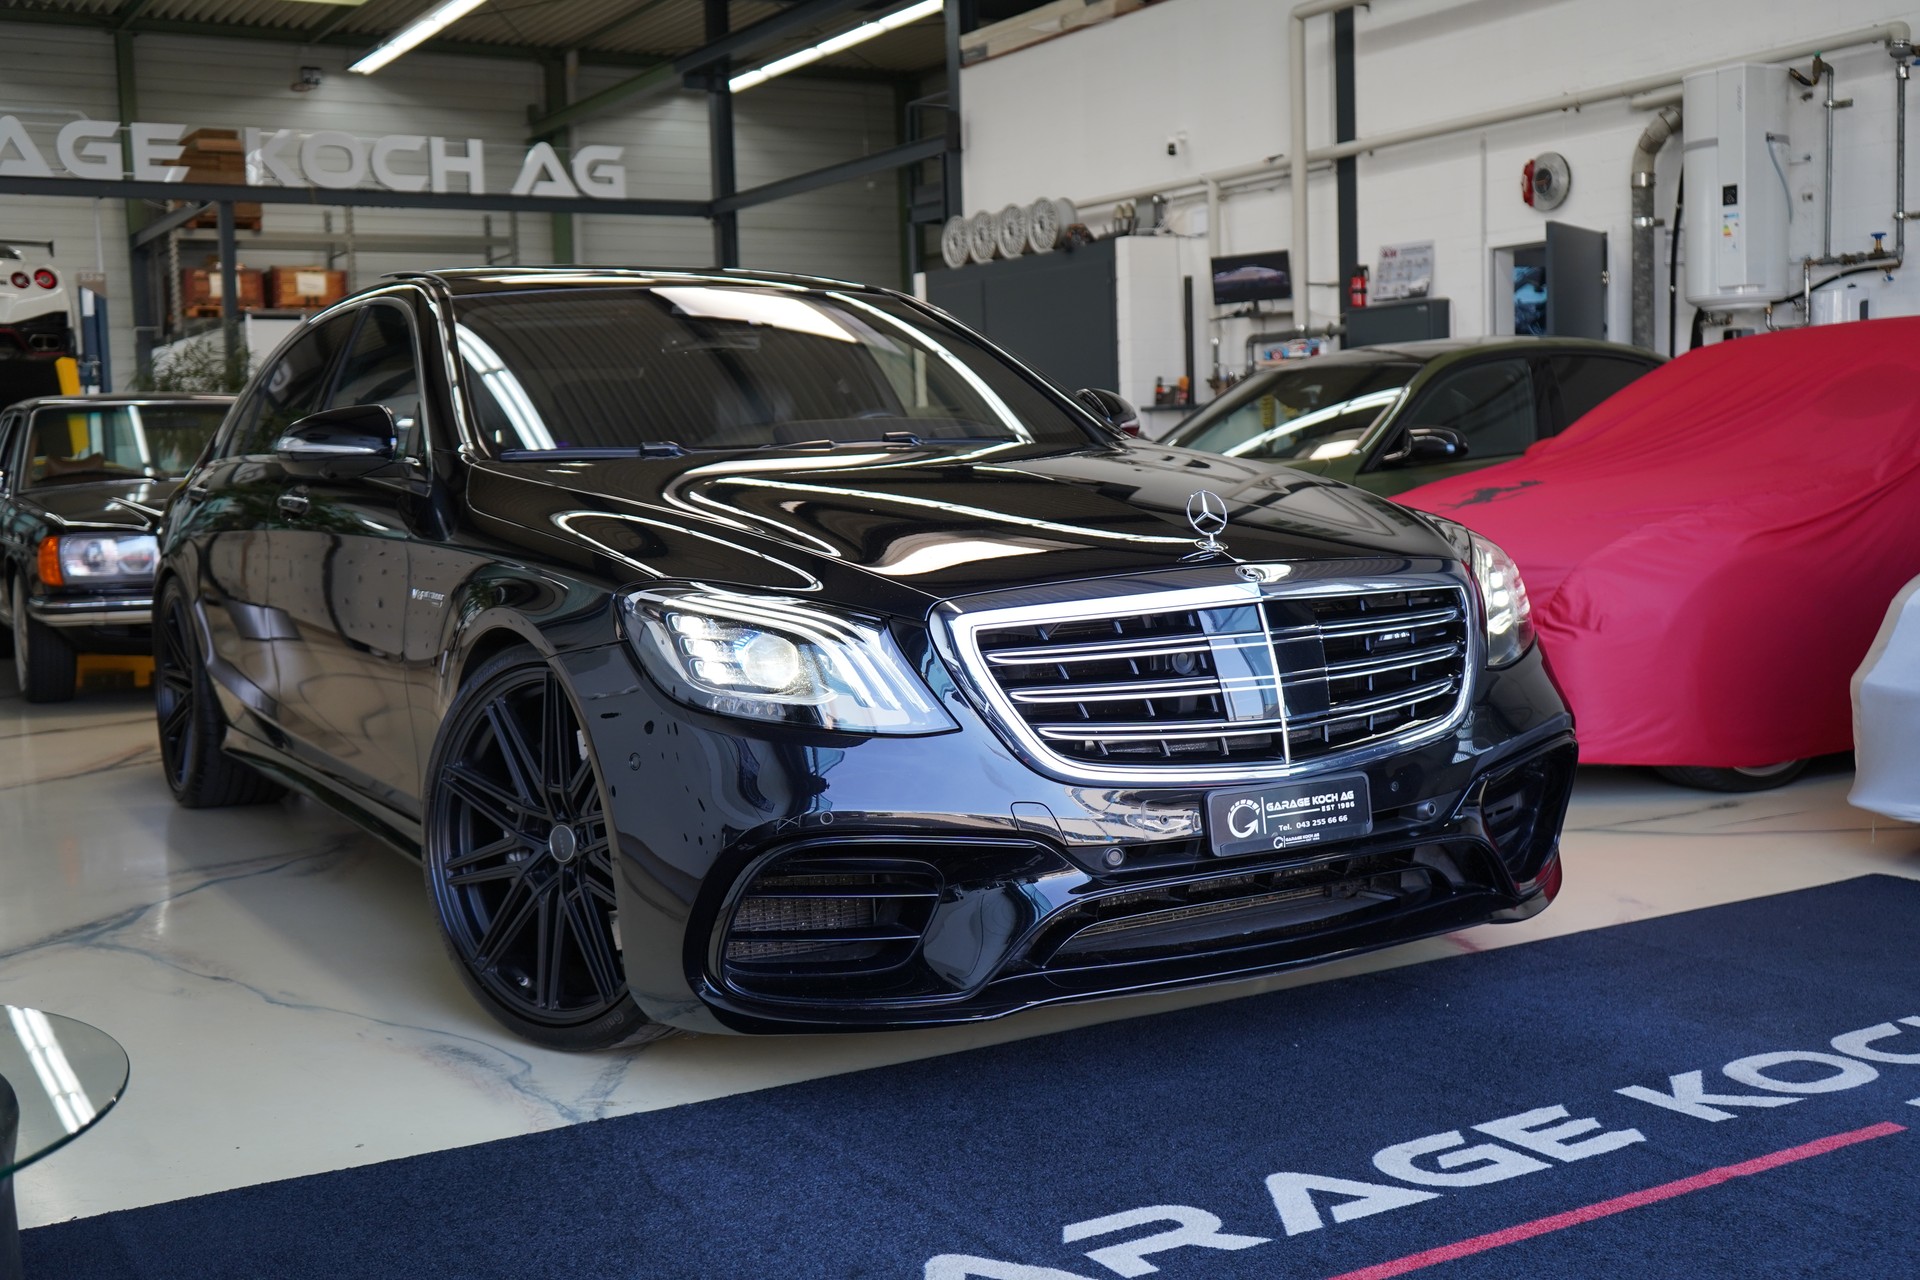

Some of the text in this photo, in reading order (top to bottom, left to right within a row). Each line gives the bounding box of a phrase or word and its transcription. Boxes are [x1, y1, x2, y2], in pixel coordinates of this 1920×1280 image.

[0, 115, 627, 199] AGE KOCH AG
[1266, 790, 1355, 812] GARAGE KOCH AG
[1321, 801, 1355, 812] EST 1986
[1278, 814, 1348, 832] Tel. 043 255 66 66
[1614, 1015, 1920, 1122] KOC
